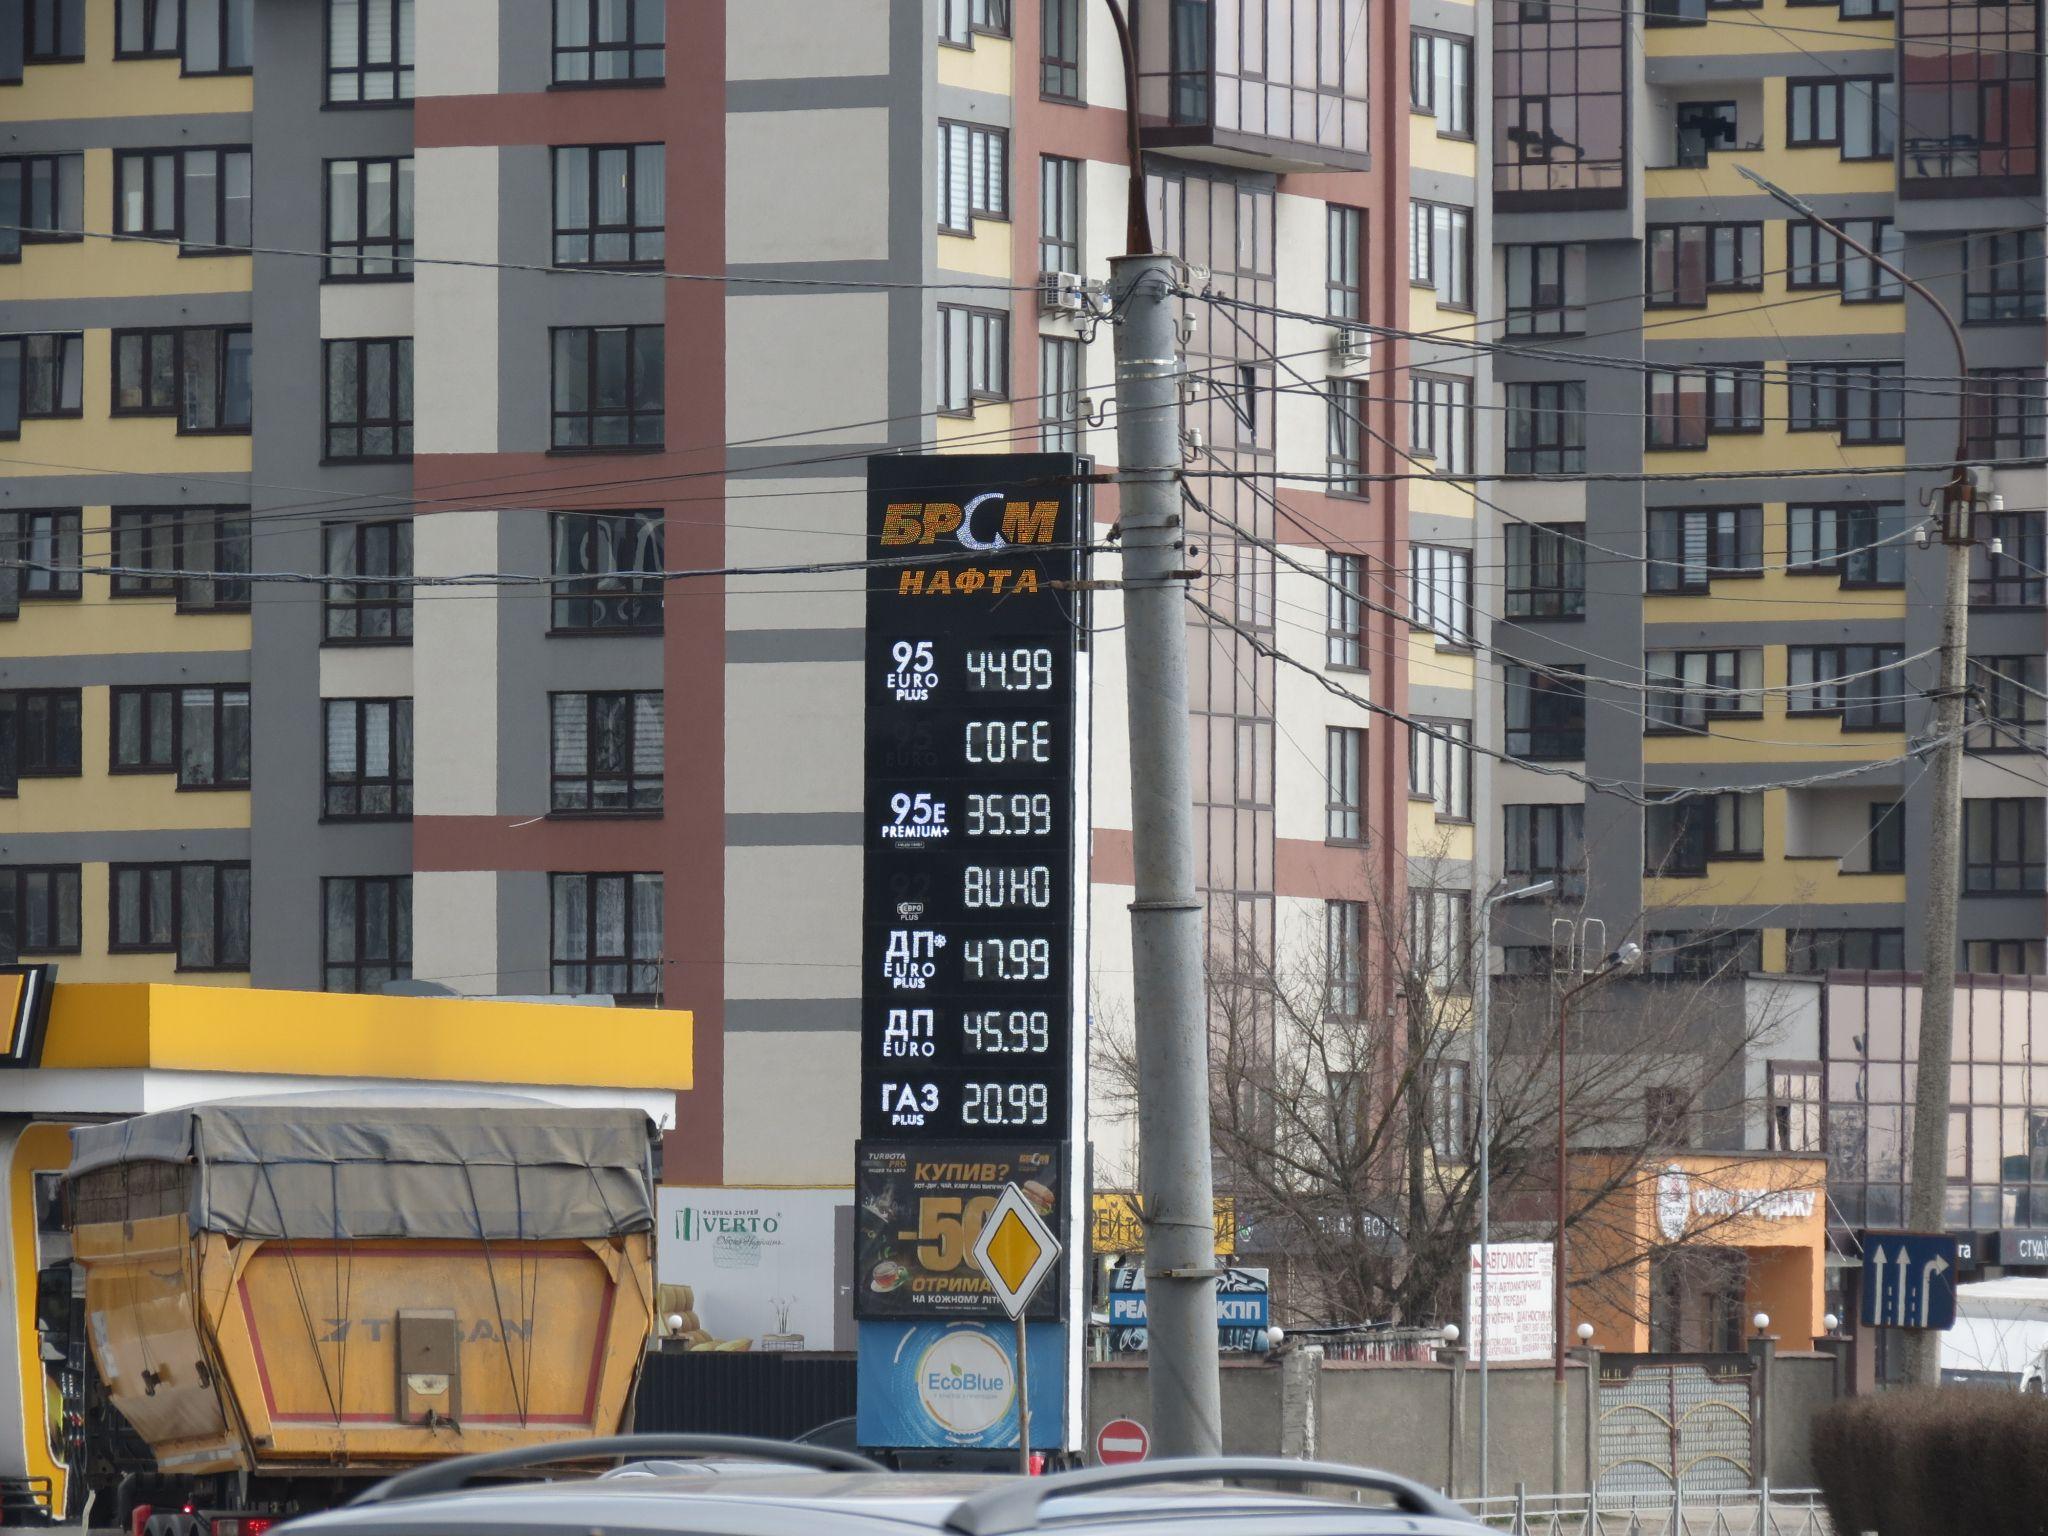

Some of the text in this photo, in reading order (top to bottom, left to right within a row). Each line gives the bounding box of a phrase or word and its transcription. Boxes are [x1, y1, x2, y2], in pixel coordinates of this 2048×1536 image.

[880, 492, 1060, 550] БРСМ
[898, 568, 1038, 595] НАФТА
[892, 641, 934, 673] 95
[967, 649, 1052, 690] 44.99
[887, 673, 939, 689] EURO
[896, 689, 929, 701] PLUS
[966, 721, 1050, 763] COFE
[890, 793, 946, 825] 95E
[968, 794, 1050, 835] 35.99
[882, 825, 950, 838] PREMIUM+
[964, 939, 1050, 980] 47.99
[884, 963, 935, 978] EURO
[893, 978, 926, 989] PLUS
[885, 1009, 934, 1042] ДП
[963, 1011, 1049, 1052] 45.99
[883, 1042, 935, 1057] EURO
[882, 1083, 939, 1112] ГАЗ
[963, 1083, 1048, 1125] 20.99
[892, 1114, 924, 1126] PLUS
[868, 1153, 906, 1161] TURBOTA
[914, 1163, 1010, 1182] КУПИВ?
[703, 1217, 778, 1233] VERTO
[912, 1278, 994, 1292] ОТРИМА
[912, 1295, 1001, 1304] НА КОЖНОМУ ЛІТР
[929, 1373, 1004, 1391] EcoBlue
